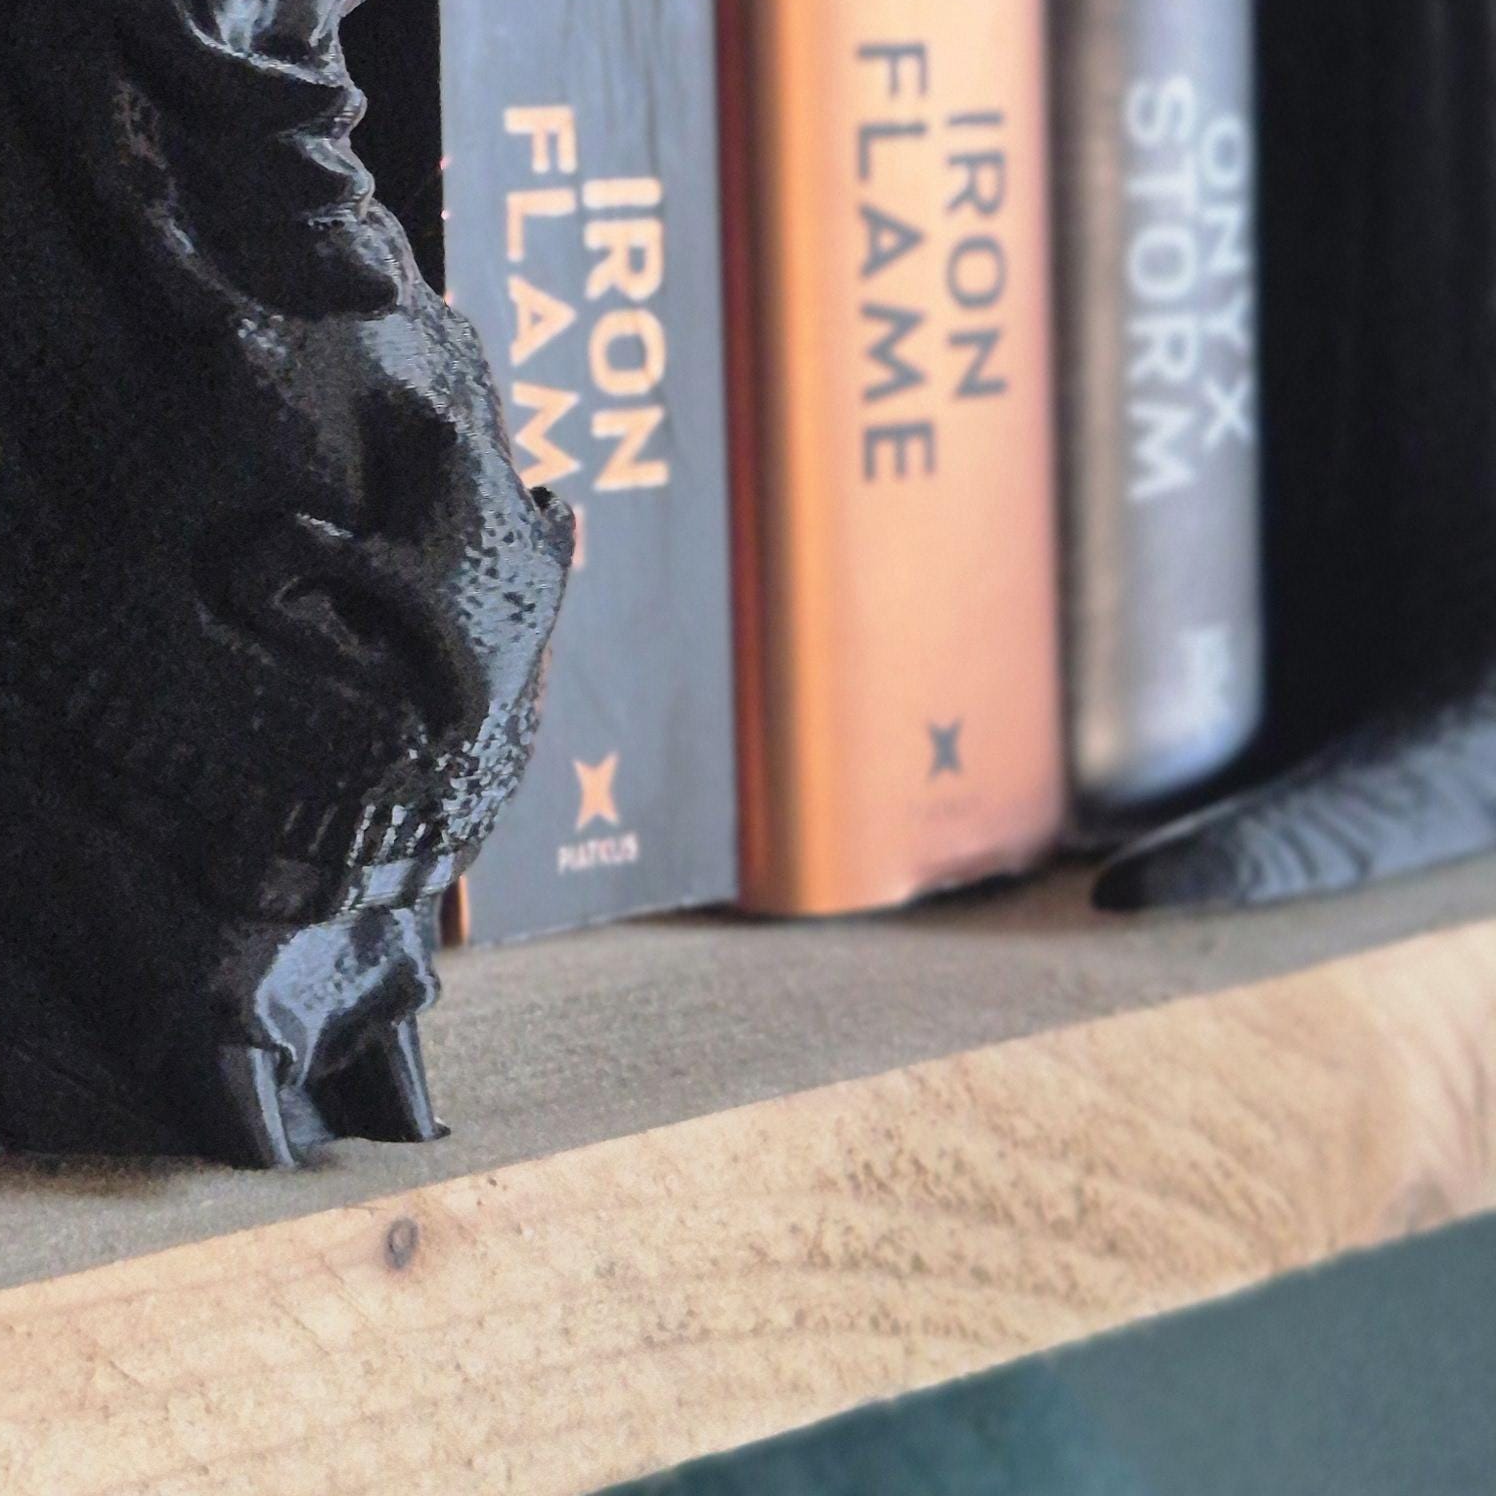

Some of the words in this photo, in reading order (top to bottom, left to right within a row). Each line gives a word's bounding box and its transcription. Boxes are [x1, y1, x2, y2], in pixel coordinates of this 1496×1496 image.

[504, 104, 585, 570] FLAM
[581, 176, 670, 492] IRON
[856, 41, 937, 483] FLAME
[943, 110, 1010, 401] IRON
[1126, 75, 1200, 504] STORM
[1202, 114, 1250, 452] ONYX
